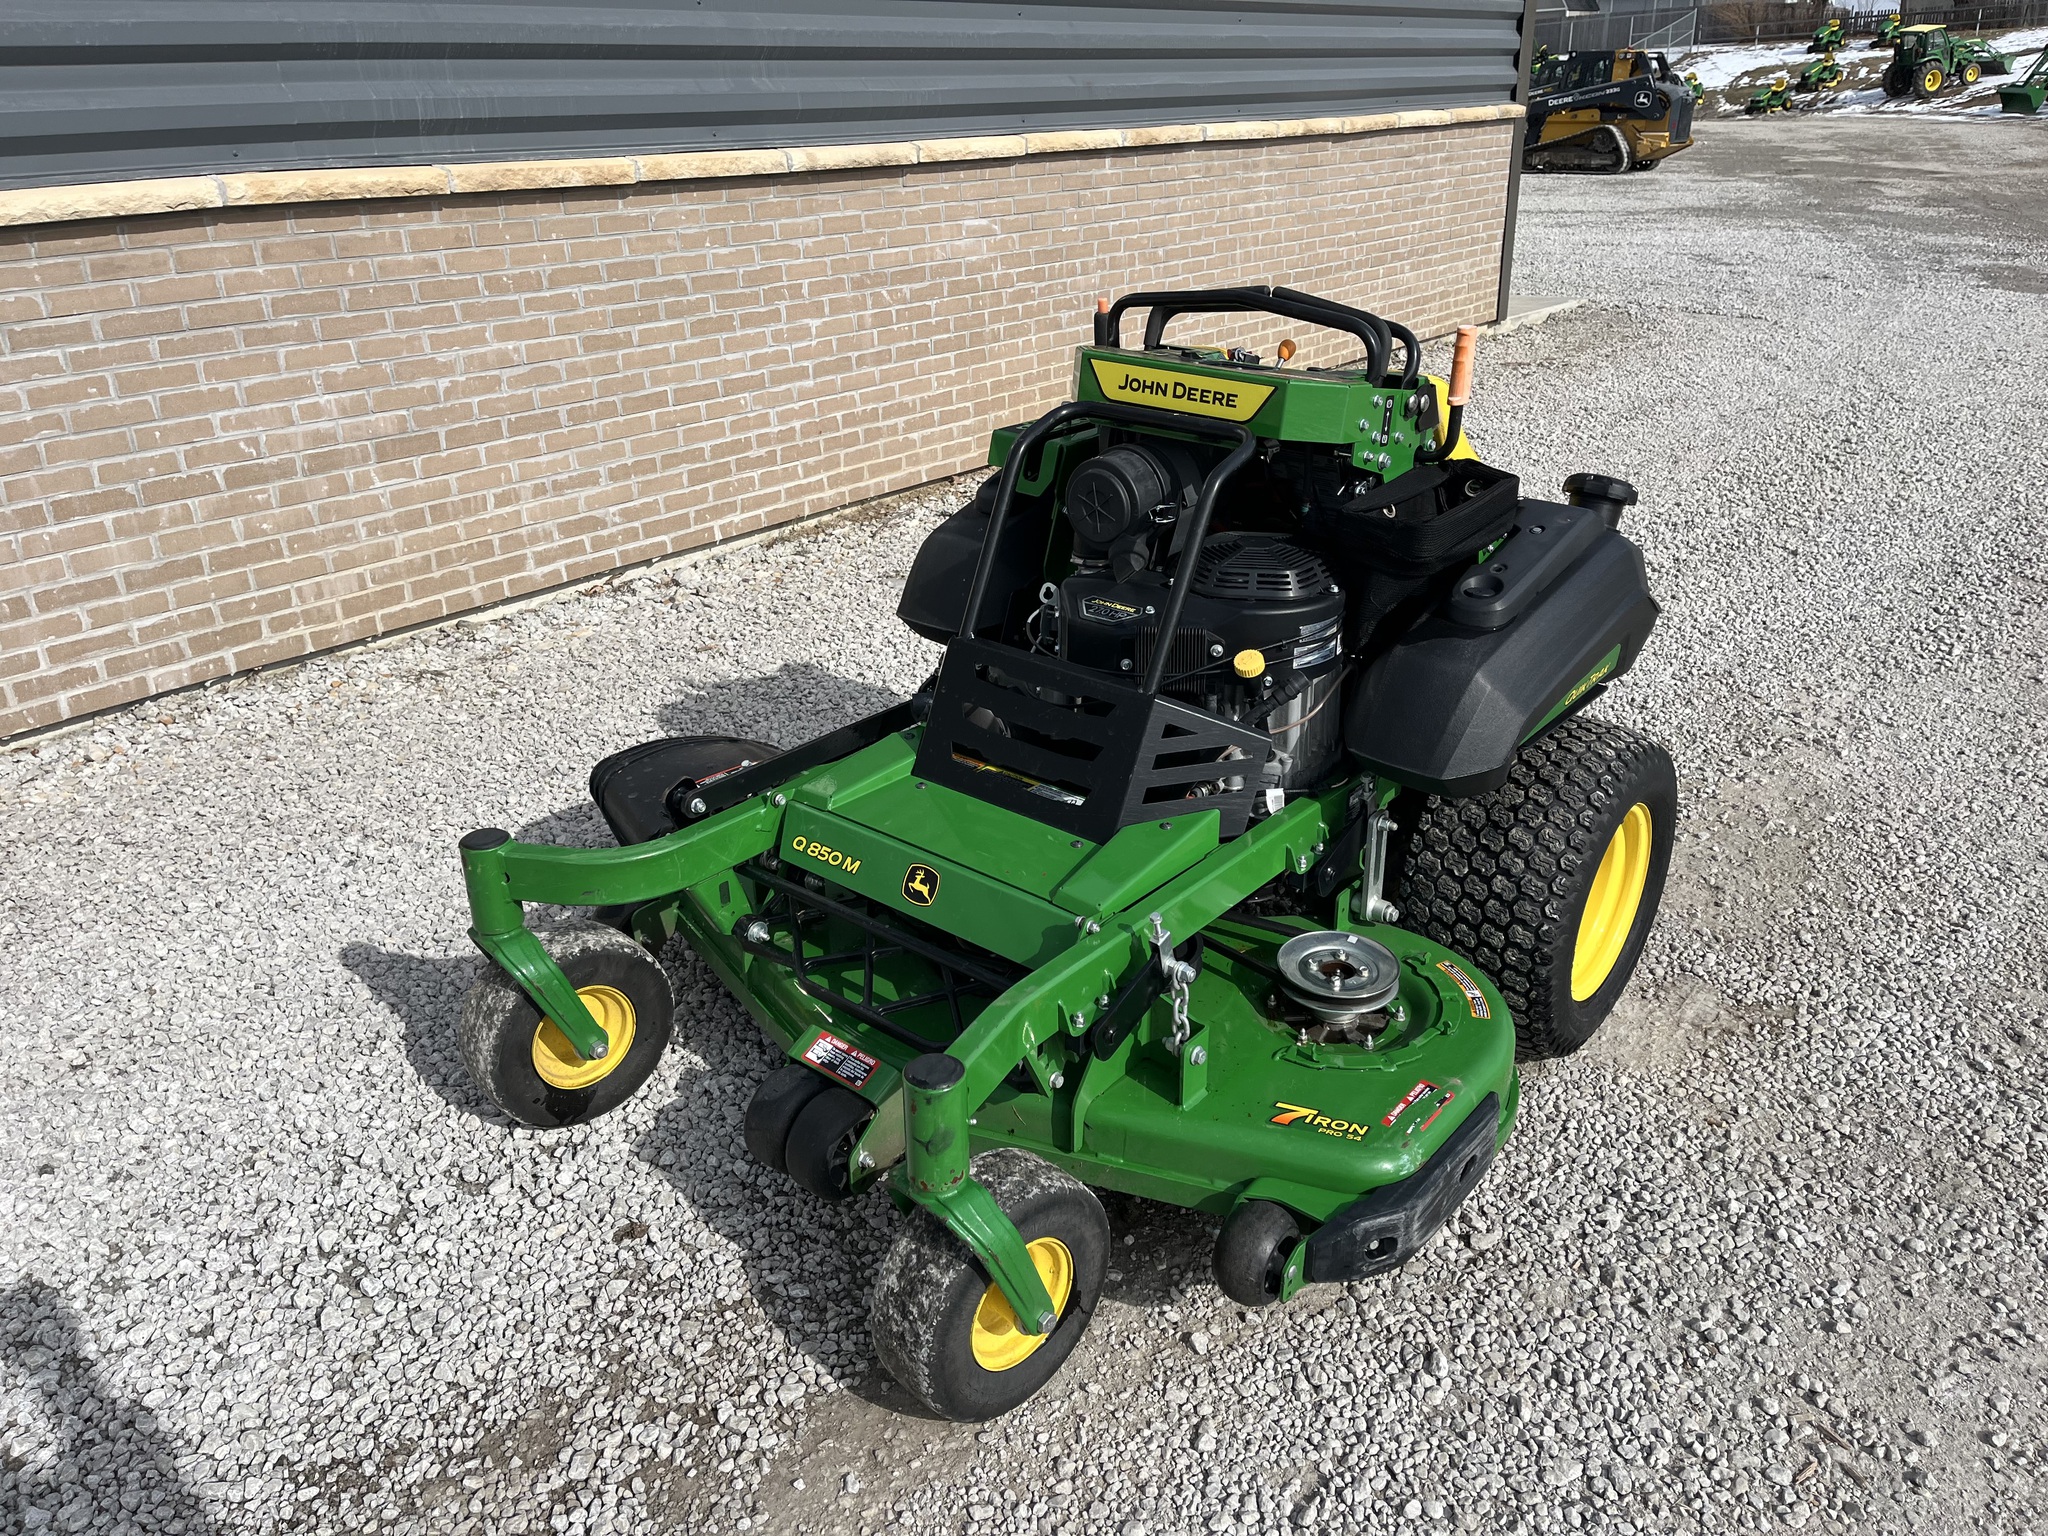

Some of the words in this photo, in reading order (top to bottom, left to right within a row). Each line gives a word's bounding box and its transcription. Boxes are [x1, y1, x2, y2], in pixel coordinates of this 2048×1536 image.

[1548, 96, 1574, 107] DEERE
[1118, 374, 1169, 397] JOHN
[1172, 382, 1239, 408] DEERE
[1091, 599, 1113, 607] JOHN
[1112, 602, 1137, 613] DEERE
[792, 836, 807, 852] Q
[806, 842, 843, 866] 850
[841, 856, 863, 875] M
[831, 1038, 849, 1051] DANGER
[856, 1052, 876, 1066] PELIGRO
[1317, 1127, 1343, 1137] PRO
[1345, 1133, 1362, 1142] 54
